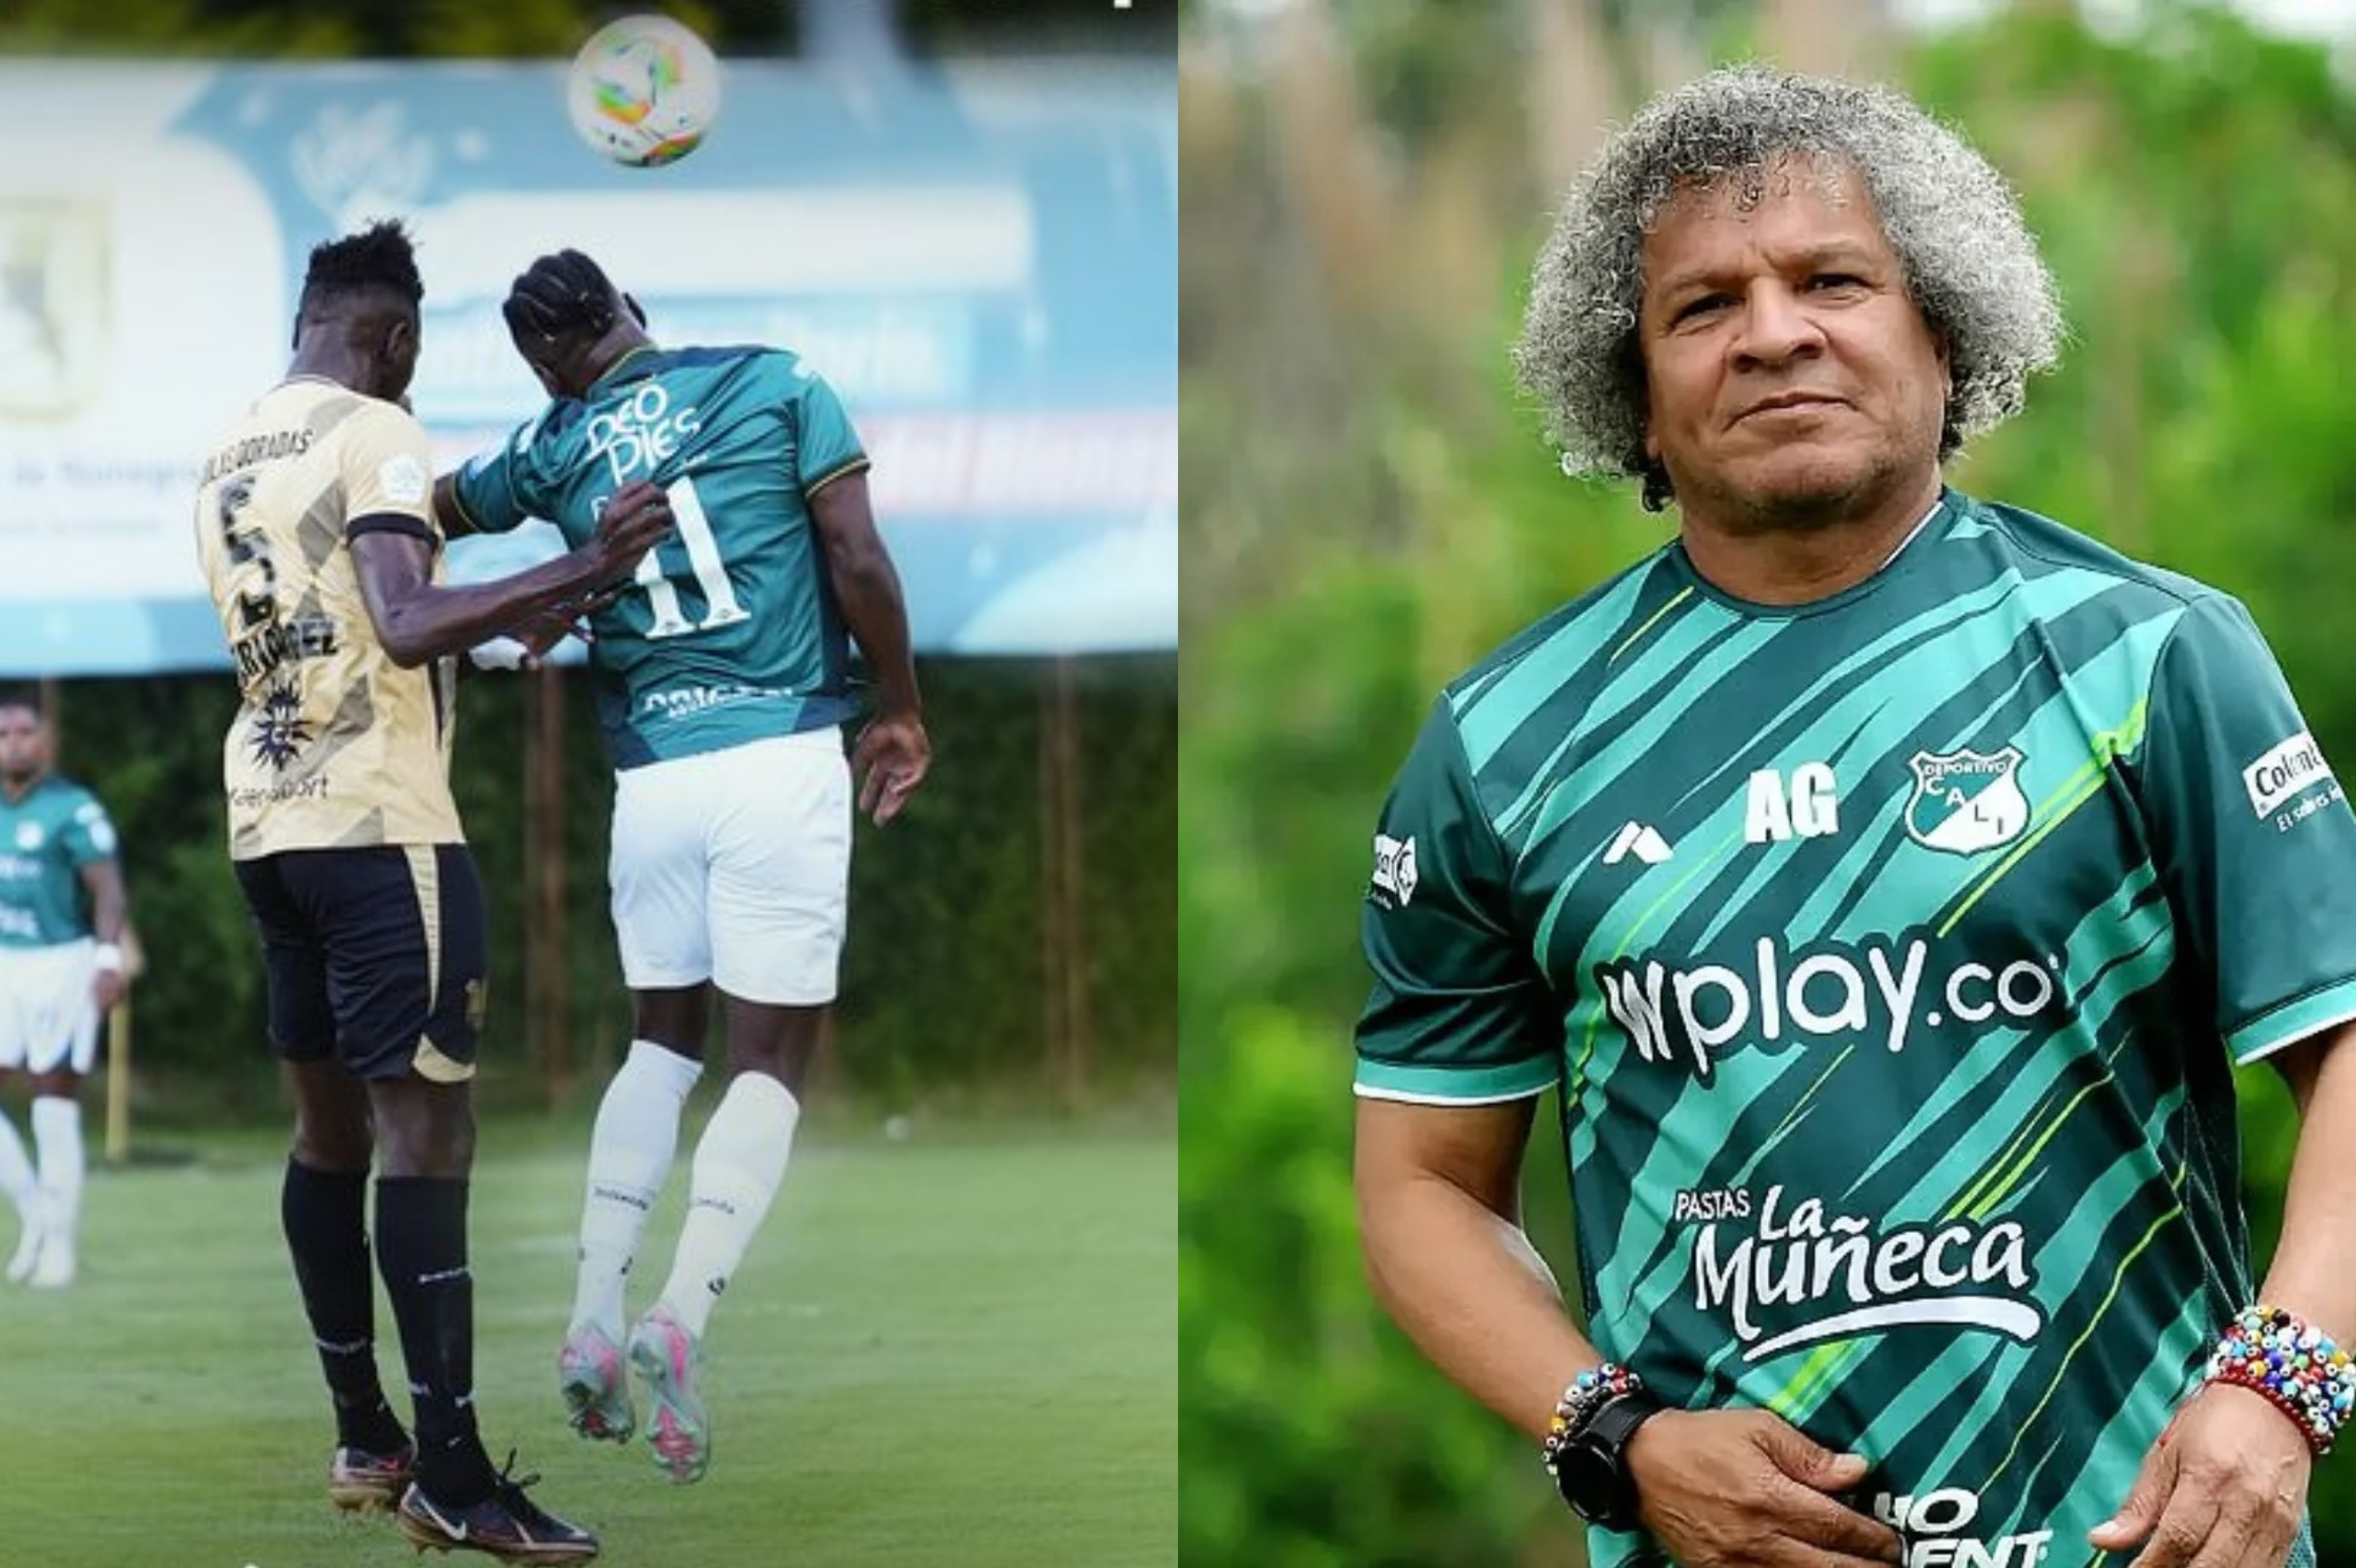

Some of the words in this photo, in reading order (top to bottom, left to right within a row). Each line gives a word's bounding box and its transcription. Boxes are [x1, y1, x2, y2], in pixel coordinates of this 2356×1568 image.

[635, 476, 753, 638] 11
[1923, 760, 2007, 776] DEPORTIVO
[1745, 761, 1839, 843] AG
[1924, 776, 2004, 836] CALI
[1676, 1189, 1751, 1221] PASTAS
[1760, 1185, 1825, 1241] La
[1694, 1215, 2030, 1341] Muñeca
[1899, 1529, 2054, 1568] ENT
